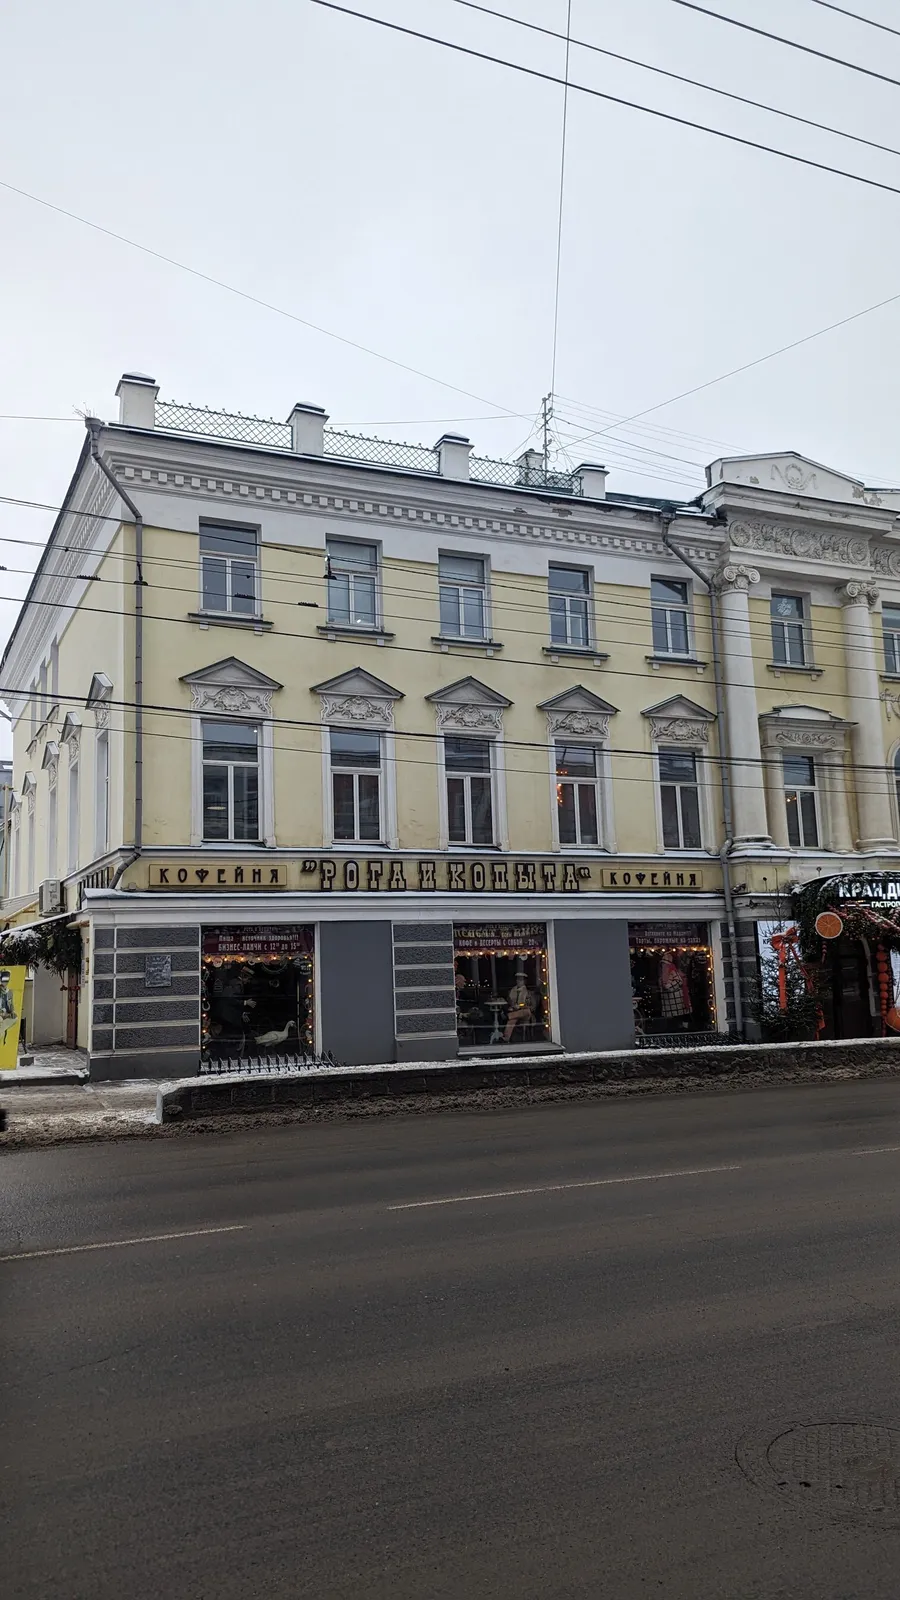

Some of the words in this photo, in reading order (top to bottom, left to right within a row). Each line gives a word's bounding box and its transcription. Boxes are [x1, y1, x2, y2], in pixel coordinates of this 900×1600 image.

[159, 866, 279, 884] КОФЕЙНЯ
[418, 860, 436, 891] И
[609, 871, 697, 886] КОФЕЙНЯ
[459, 939, 473, 947] КОФЕ
[480, 939, 502, 947] ДЕСЕРТЫ
